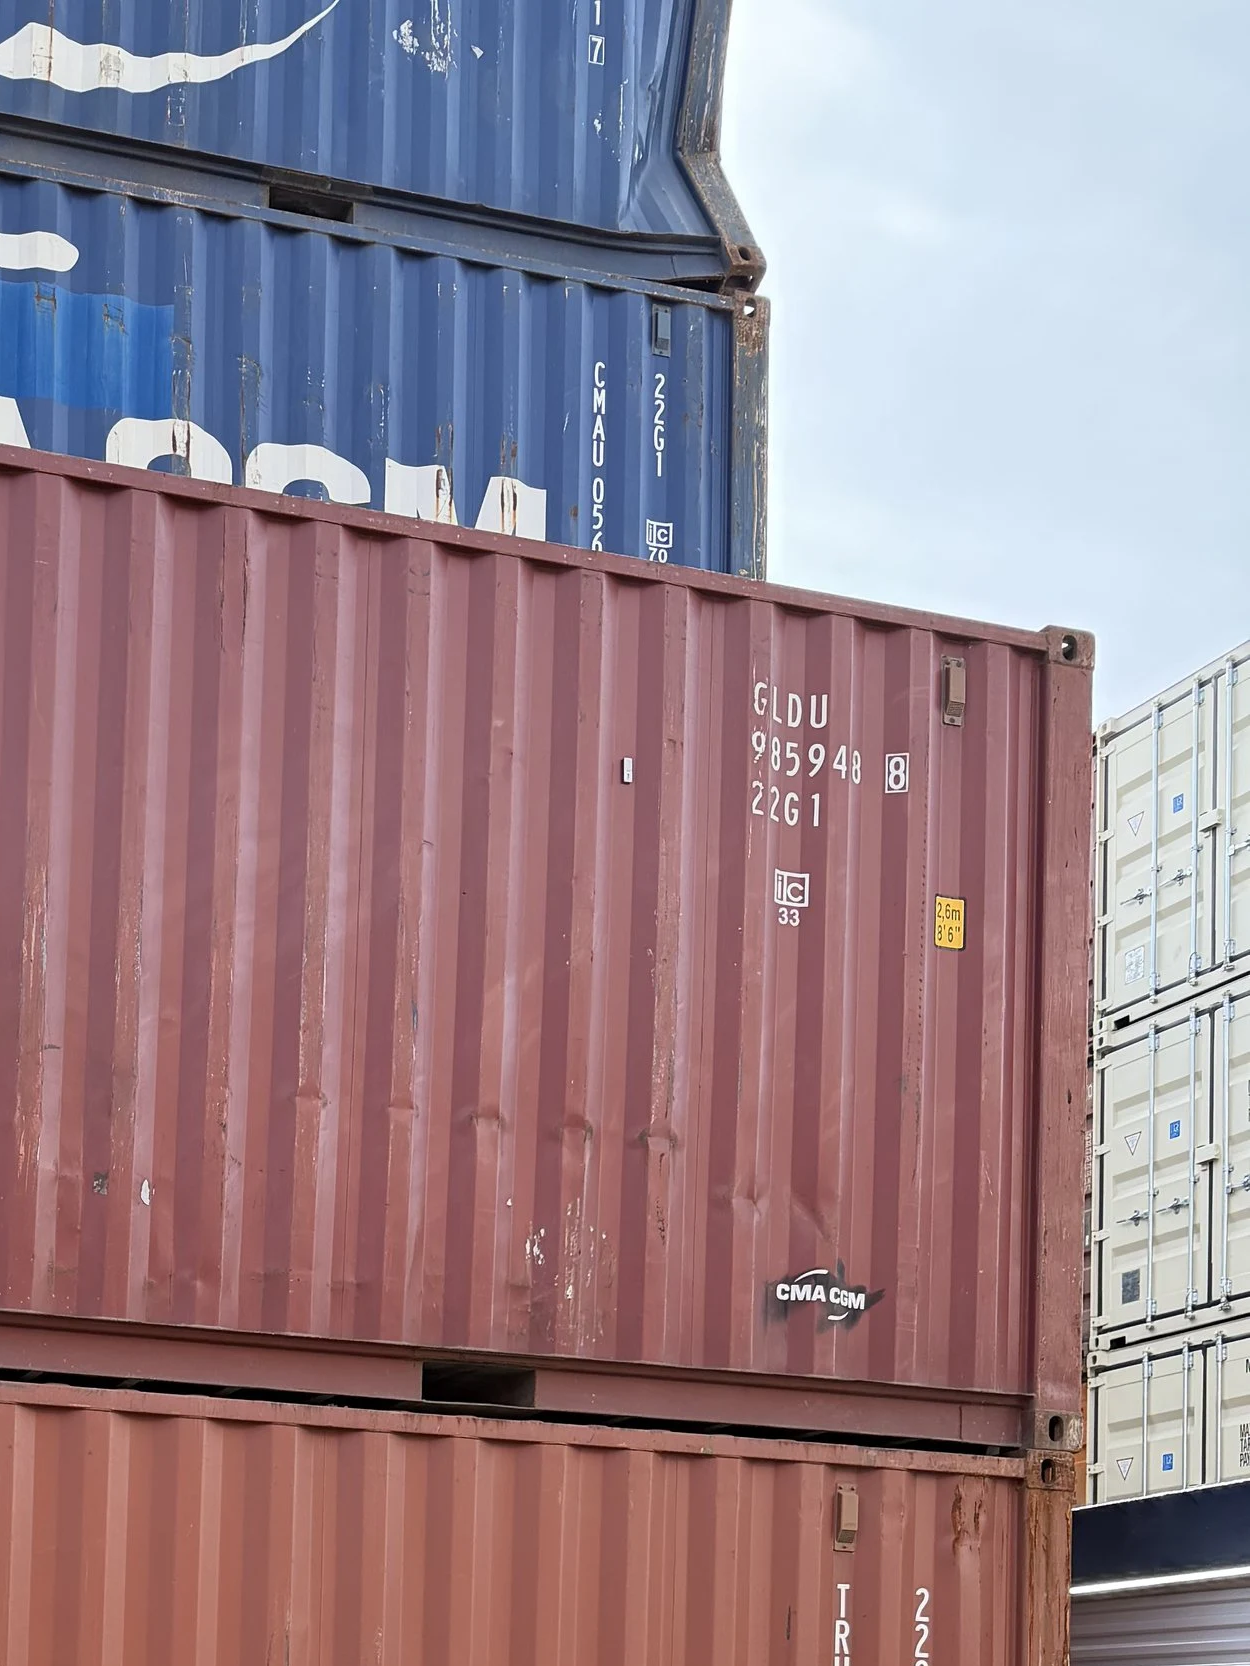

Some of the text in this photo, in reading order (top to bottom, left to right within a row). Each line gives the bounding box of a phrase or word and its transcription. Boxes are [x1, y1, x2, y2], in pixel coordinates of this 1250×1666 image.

[592, 361, 606, 467] CMAU
[653, 373, 666, 477] 22G1
[648, 546, 668, 563] 70
[753, 681, 829, 729] GLDU
[751, 731, 906, 790] 985948 8
[751, 780, 821, 827] 22G1
[778, 907, 801, 927] 33
[776, 1283, 866, 1310] CMA CGM
